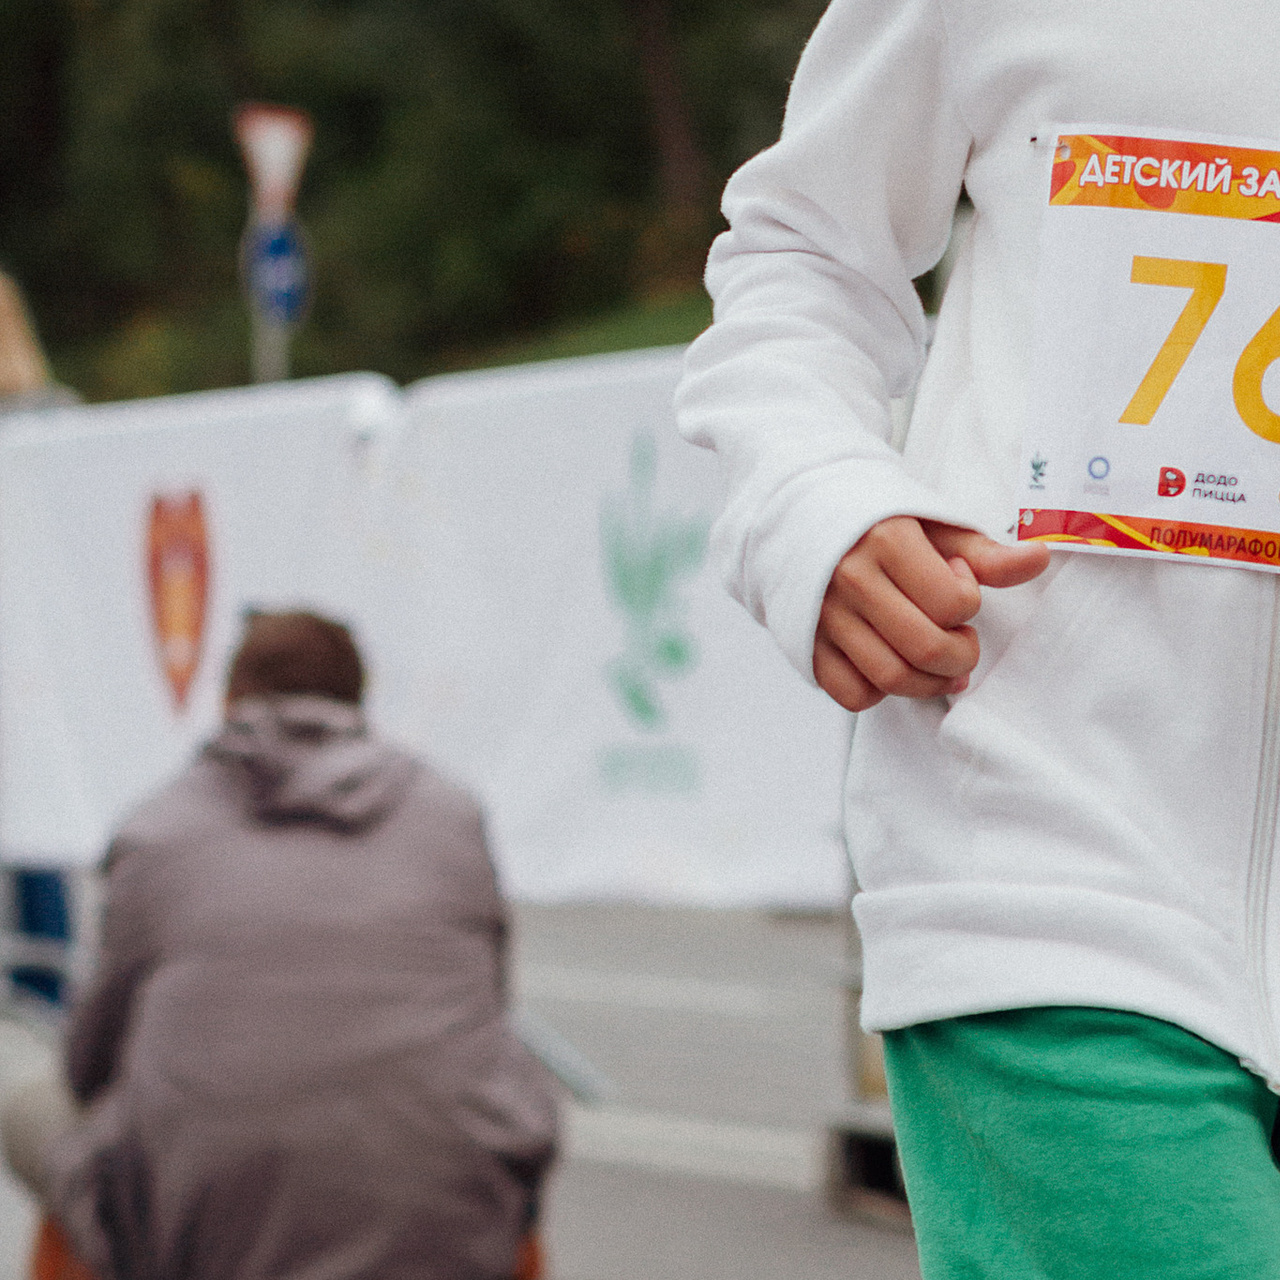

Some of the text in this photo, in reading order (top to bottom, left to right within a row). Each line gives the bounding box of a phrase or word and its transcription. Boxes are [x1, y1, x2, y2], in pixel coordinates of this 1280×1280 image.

[1079, 153, 1233, 194] ДЕТСКИЙ
[1194, 472, 1239, 487] ДОДО
[1192, 487, 1247, 504] ПИЦЦА
